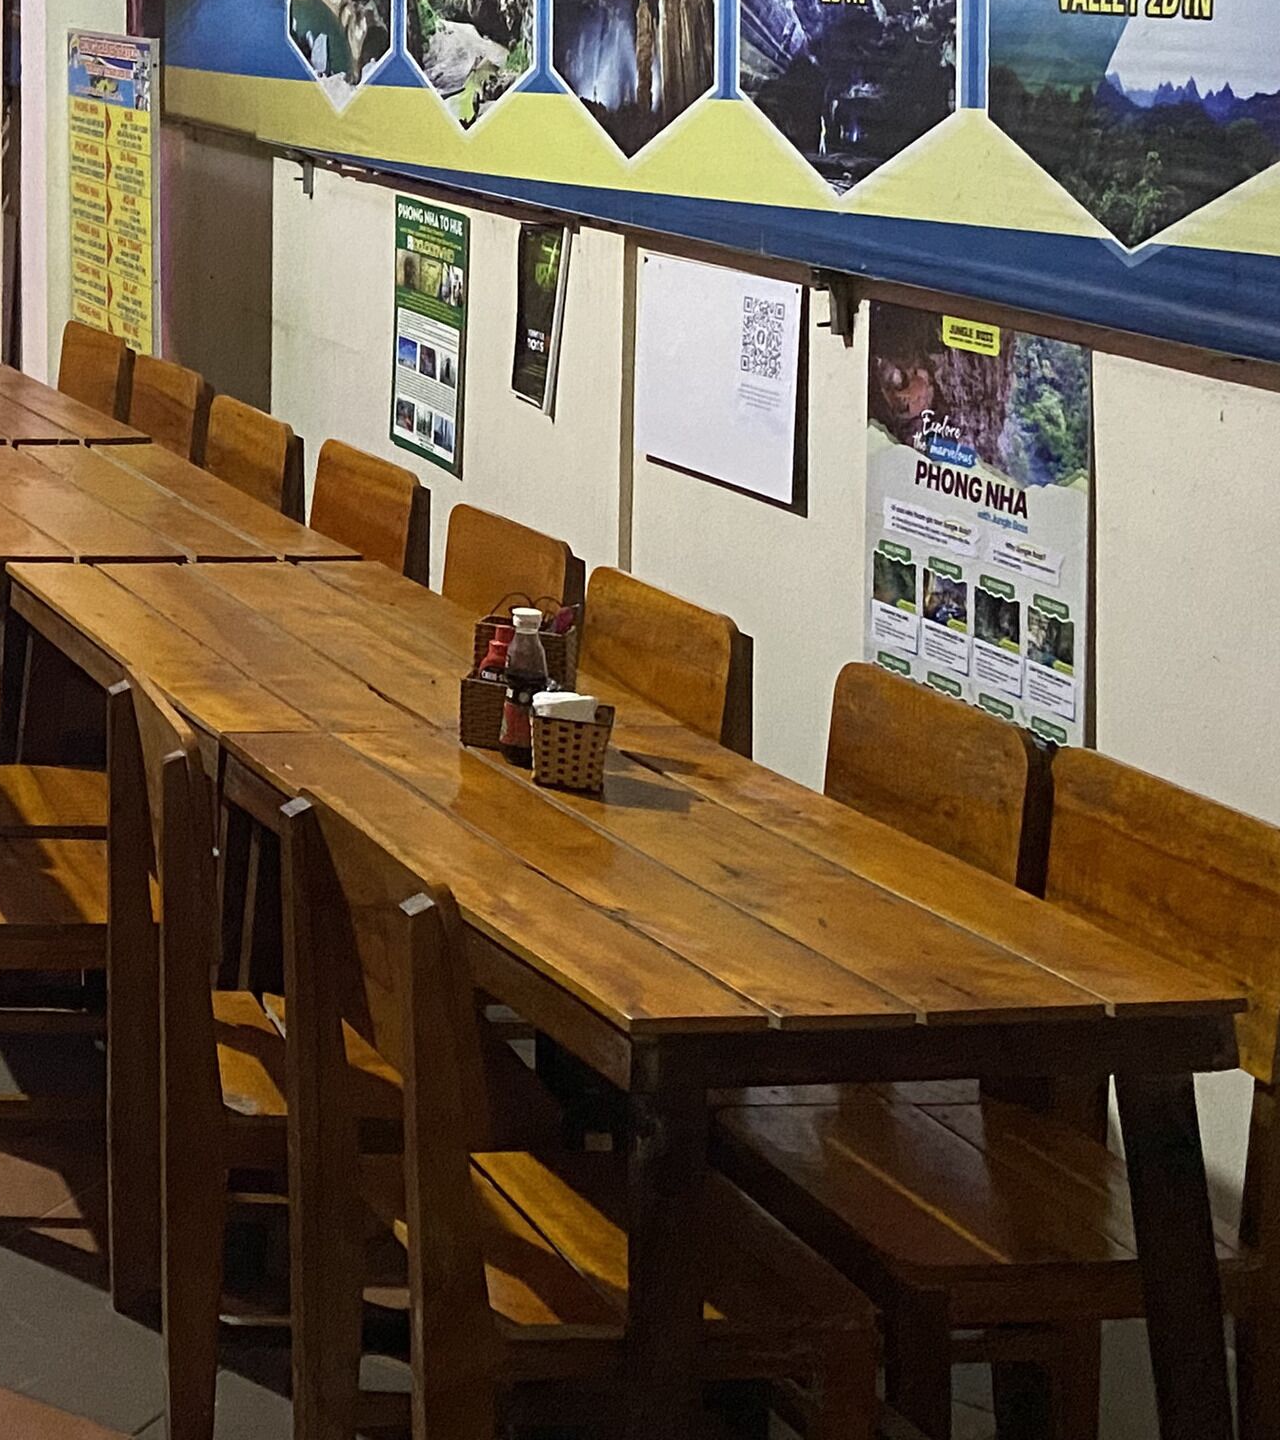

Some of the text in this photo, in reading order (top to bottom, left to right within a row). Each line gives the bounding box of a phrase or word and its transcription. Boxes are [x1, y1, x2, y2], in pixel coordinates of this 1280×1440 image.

[397, 203, 423, 224] PHONG
[921, 410, 962, 443] Explore
[915, 460, 982, 503] PHONG
[985, 481, 1028, 519] NHA
